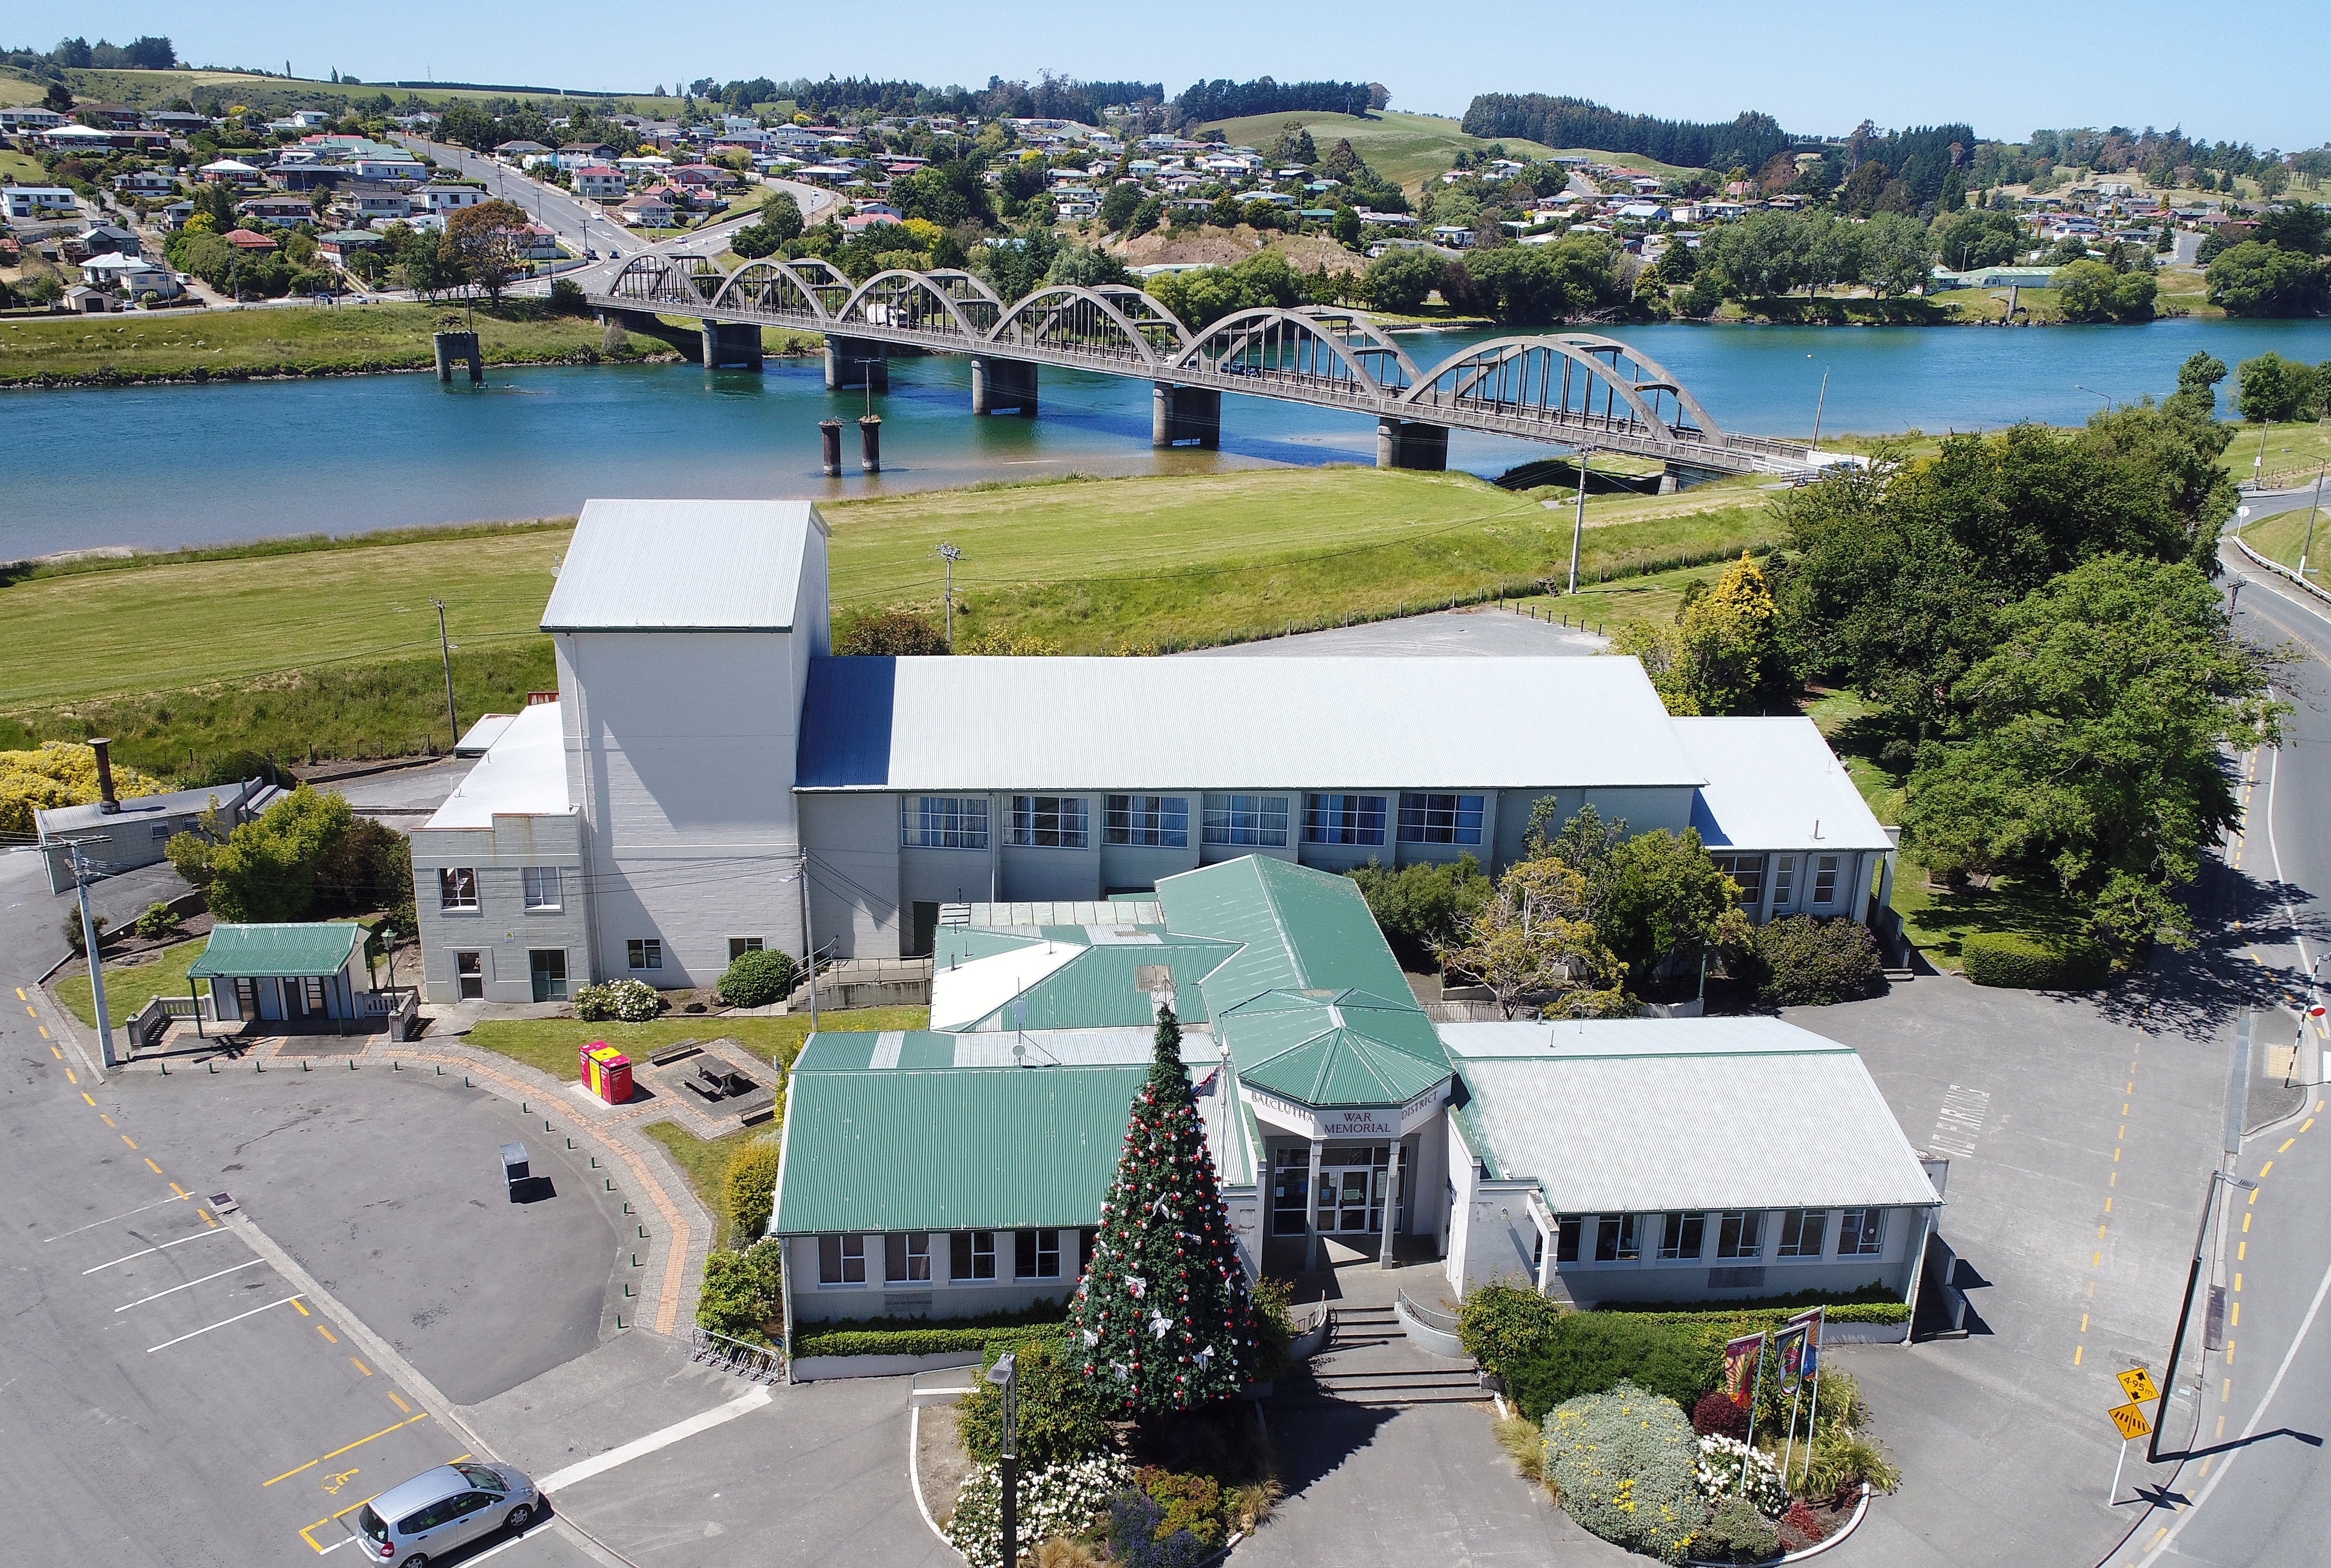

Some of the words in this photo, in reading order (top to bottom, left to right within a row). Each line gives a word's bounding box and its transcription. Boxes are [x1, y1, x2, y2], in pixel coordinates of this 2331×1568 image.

[1251, 1091, 1315, 1124] BALCLUTHA
[1344, 1113, 1372, 1122] WAR
[1401, 1091, 1438, 1121] DISTRICT
[1935, 1084, 1990, 1137] PARKING
[1324, 1123, 1391, 1134] MEMORIAL
[1929, 1133, 1975, 1158] NO
